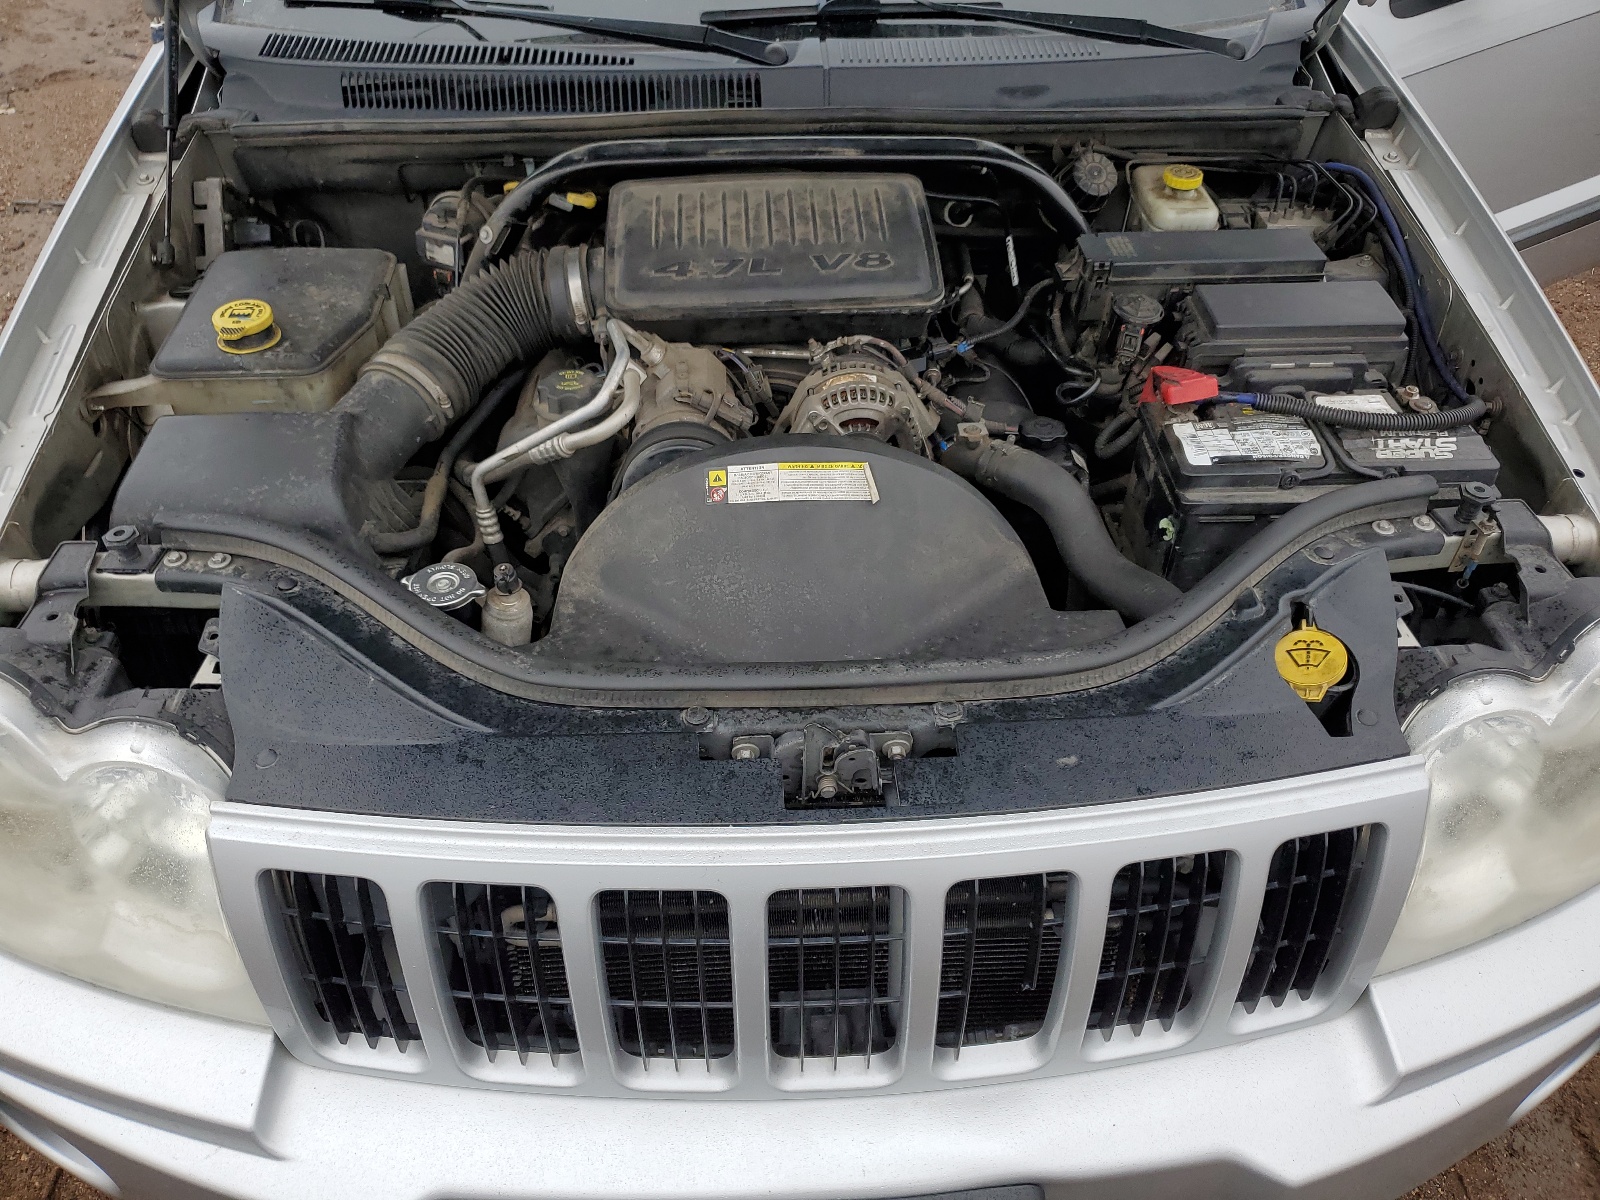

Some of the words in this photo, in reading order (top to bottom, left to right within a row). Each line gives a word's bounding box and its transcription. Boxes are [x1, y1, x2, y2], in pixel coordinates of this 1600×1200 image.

[650, 258, 783, 279] 4.7L
[810, 252, 895, 274] V8
[1379, 429, 1449, 437] PLATINUM
[1376, 437, 1457, 451] START
[1376, 449, 1454, 460] SUPER
